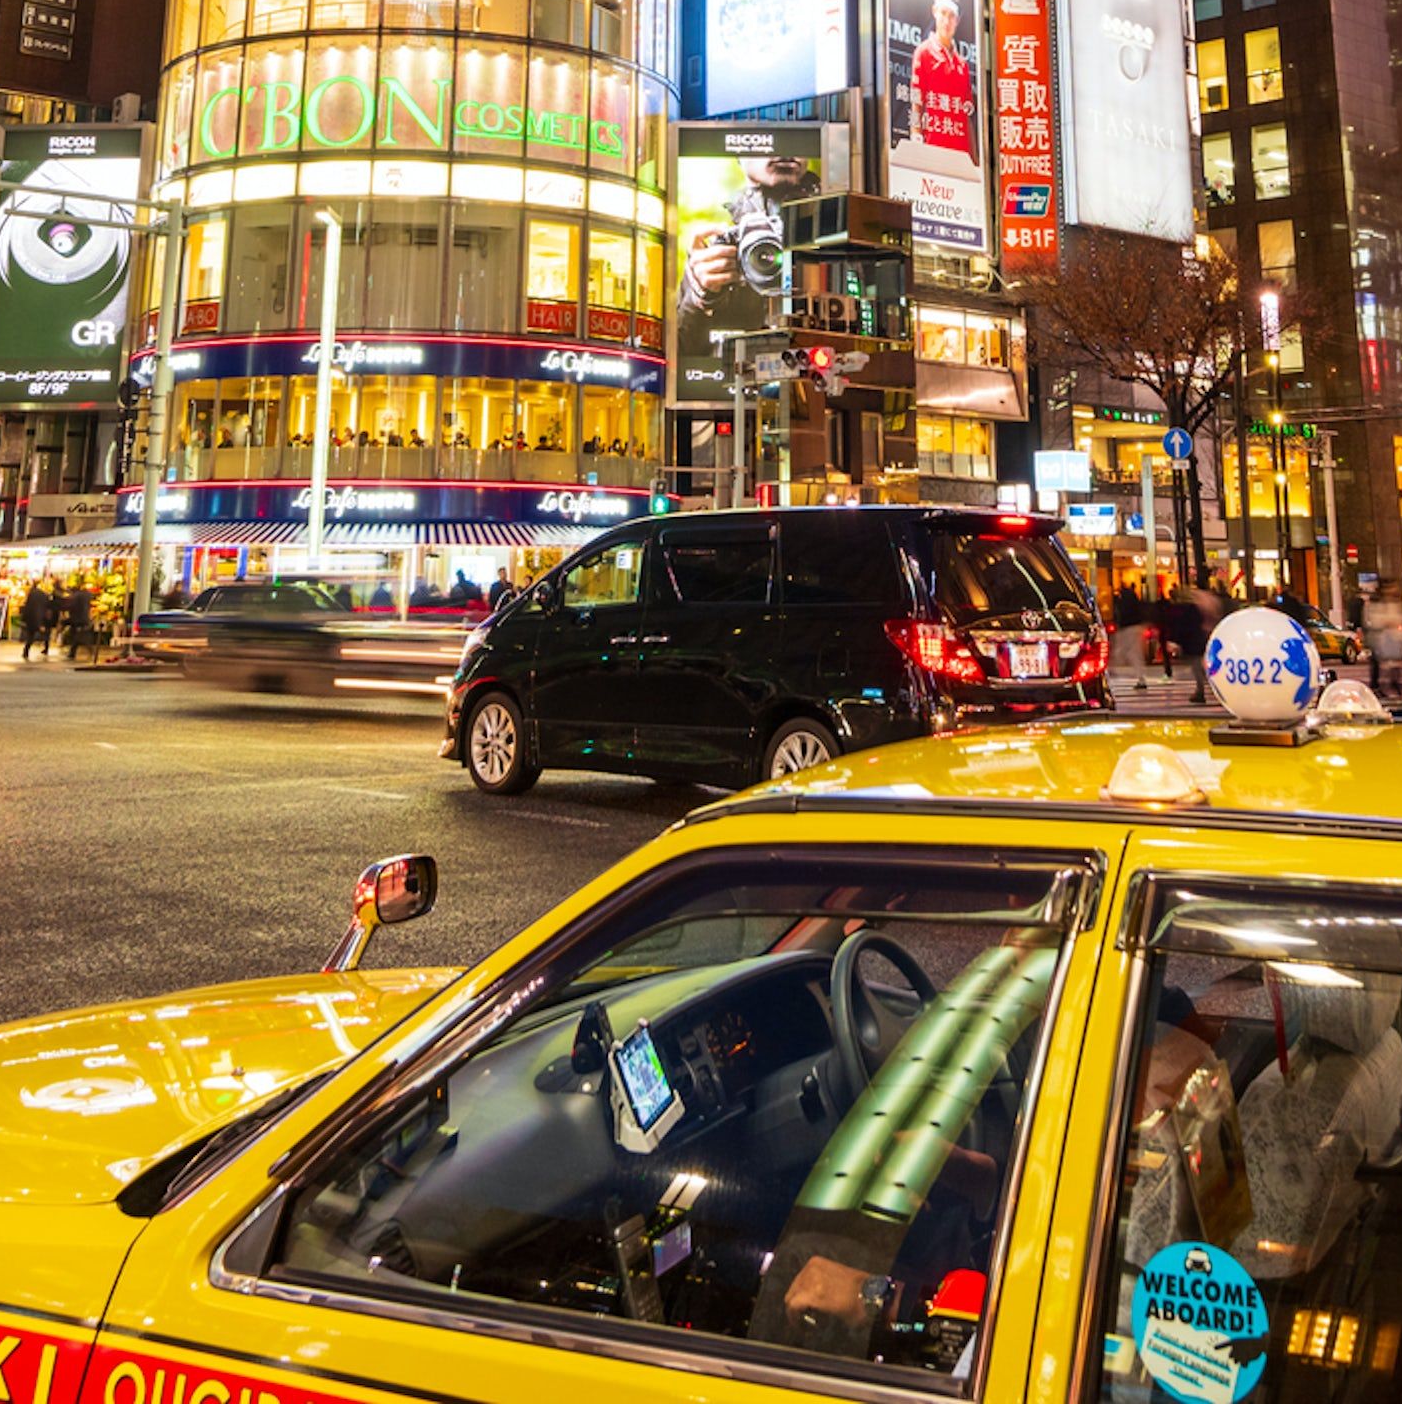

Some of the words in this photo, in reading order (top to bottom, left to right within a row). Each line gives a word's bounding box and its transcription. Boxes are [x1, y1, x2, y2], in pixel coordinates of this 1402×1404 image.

[888, 18, 922, 46] IMG
[1002, 34, 1040, 77] 質
[998, 78, 1049, 113] 買取
[201, 74, 454, 158] C'BON
[1088, 107, 1176, 152] TASAKI
[48, 135, 96, 147] RICOH
[725, 134, 774, 146] RICOH
[1000, 115, 1050, 150] 販売
[919, 177, 955, 200] New
[1019, 228, 1056, 249] B1F
[70, 319, 117, 346] GR
[531, 306, 574, 328] HAIR
[589, 314, 628, 334] SALON
[27, 383, 70, 396] 8F/9F
[1225, 656, 1284, 686] 3822
[1142, 1270, 1259, 1309] WELCOME
[1145, 1297, 1254, 1335] ABOARD!
